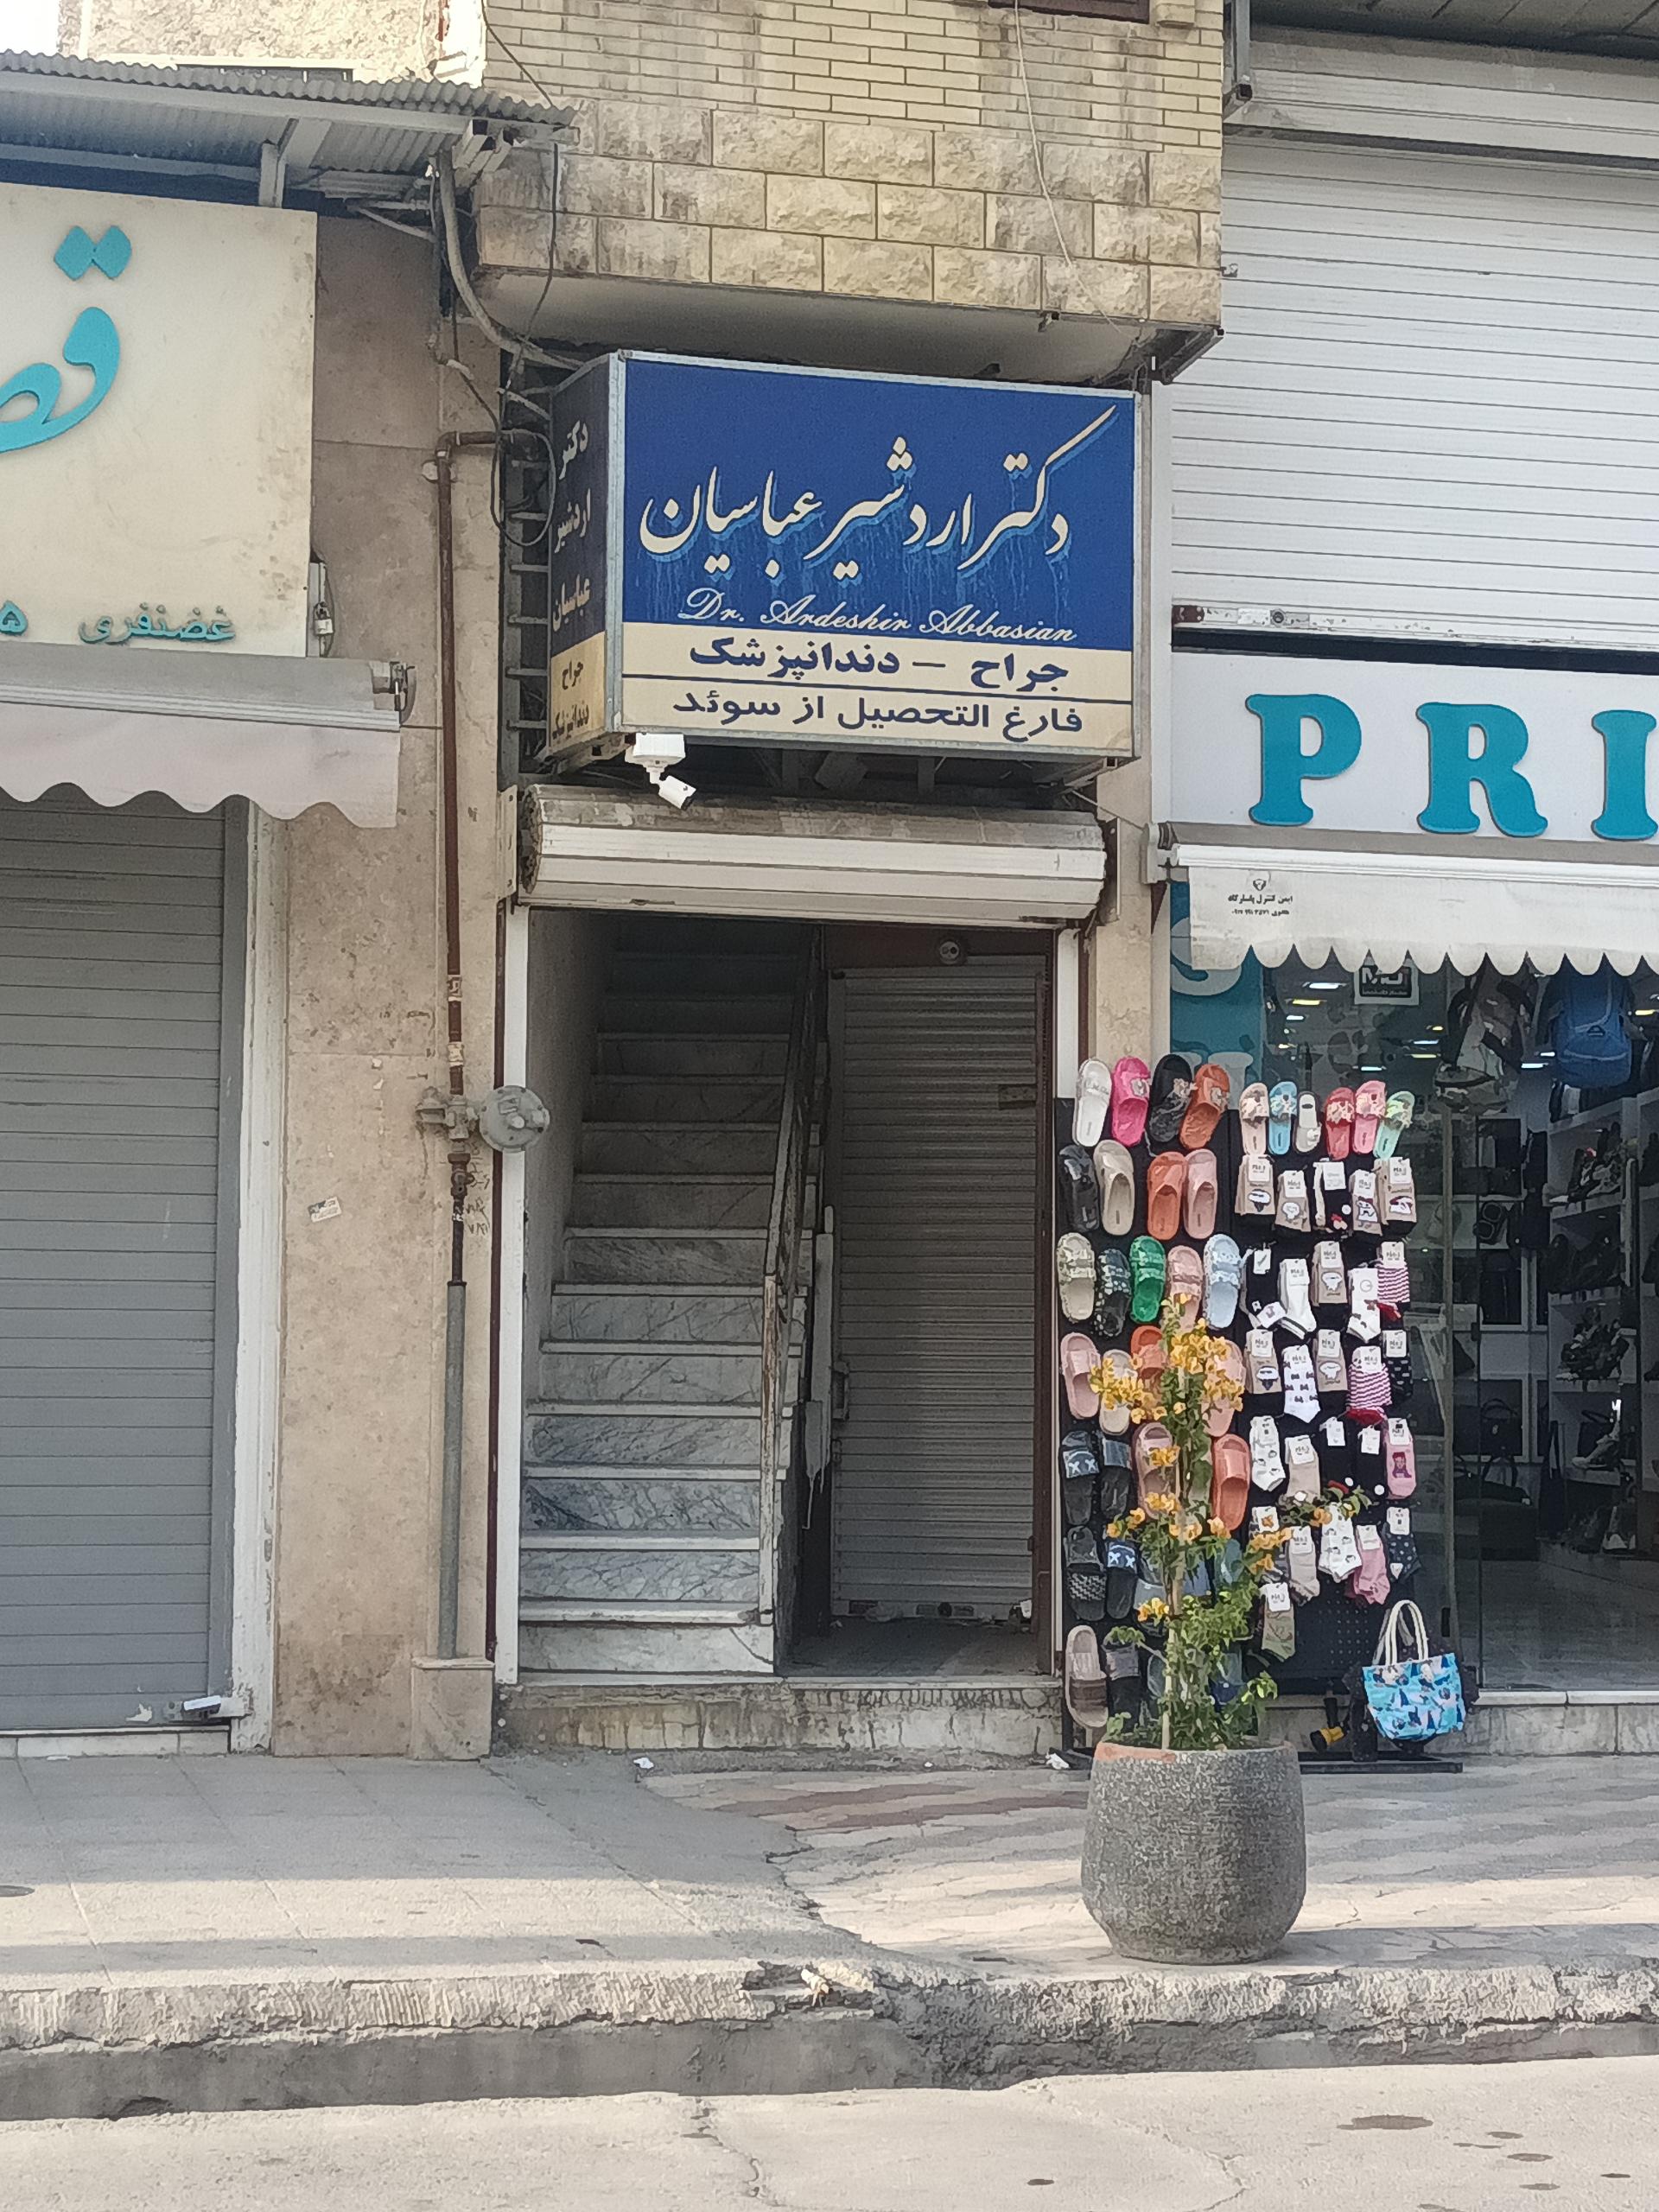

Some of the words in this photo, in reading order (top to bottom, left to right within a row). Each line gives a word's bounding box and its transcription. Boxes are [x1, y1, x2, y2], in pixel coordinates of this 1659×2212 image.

[558, 420, 589, 480] دکتر
[802, 436, 972, 581] اردشیر
[957, 404, 1116, 570] دکتر
[554, 487, 592, 554] اردشیر
[639, 466, 823, 578] عباسیان
[78, 601, 237, 646] غضنفری
[551, 574, 591, 632] عباسیان
[677, 587, 745, 622] Dr.
[760, 594, 911, 631] Ardeshir
[919, 603, 1077, 642] Abbasian
[562, 660, 584, 690] جراح
[690, 636, 900, 681] دندانپزشک
[970, 652, 1069, 693] جراح
[672, 690, 781, 726] سوئد
[792, 695, 823, 725] از
[837, 695, 989, 730] التحصیل
[1002, 705, 1083, 743] فارغ
[1245, 693, 1658, 840] PRI
